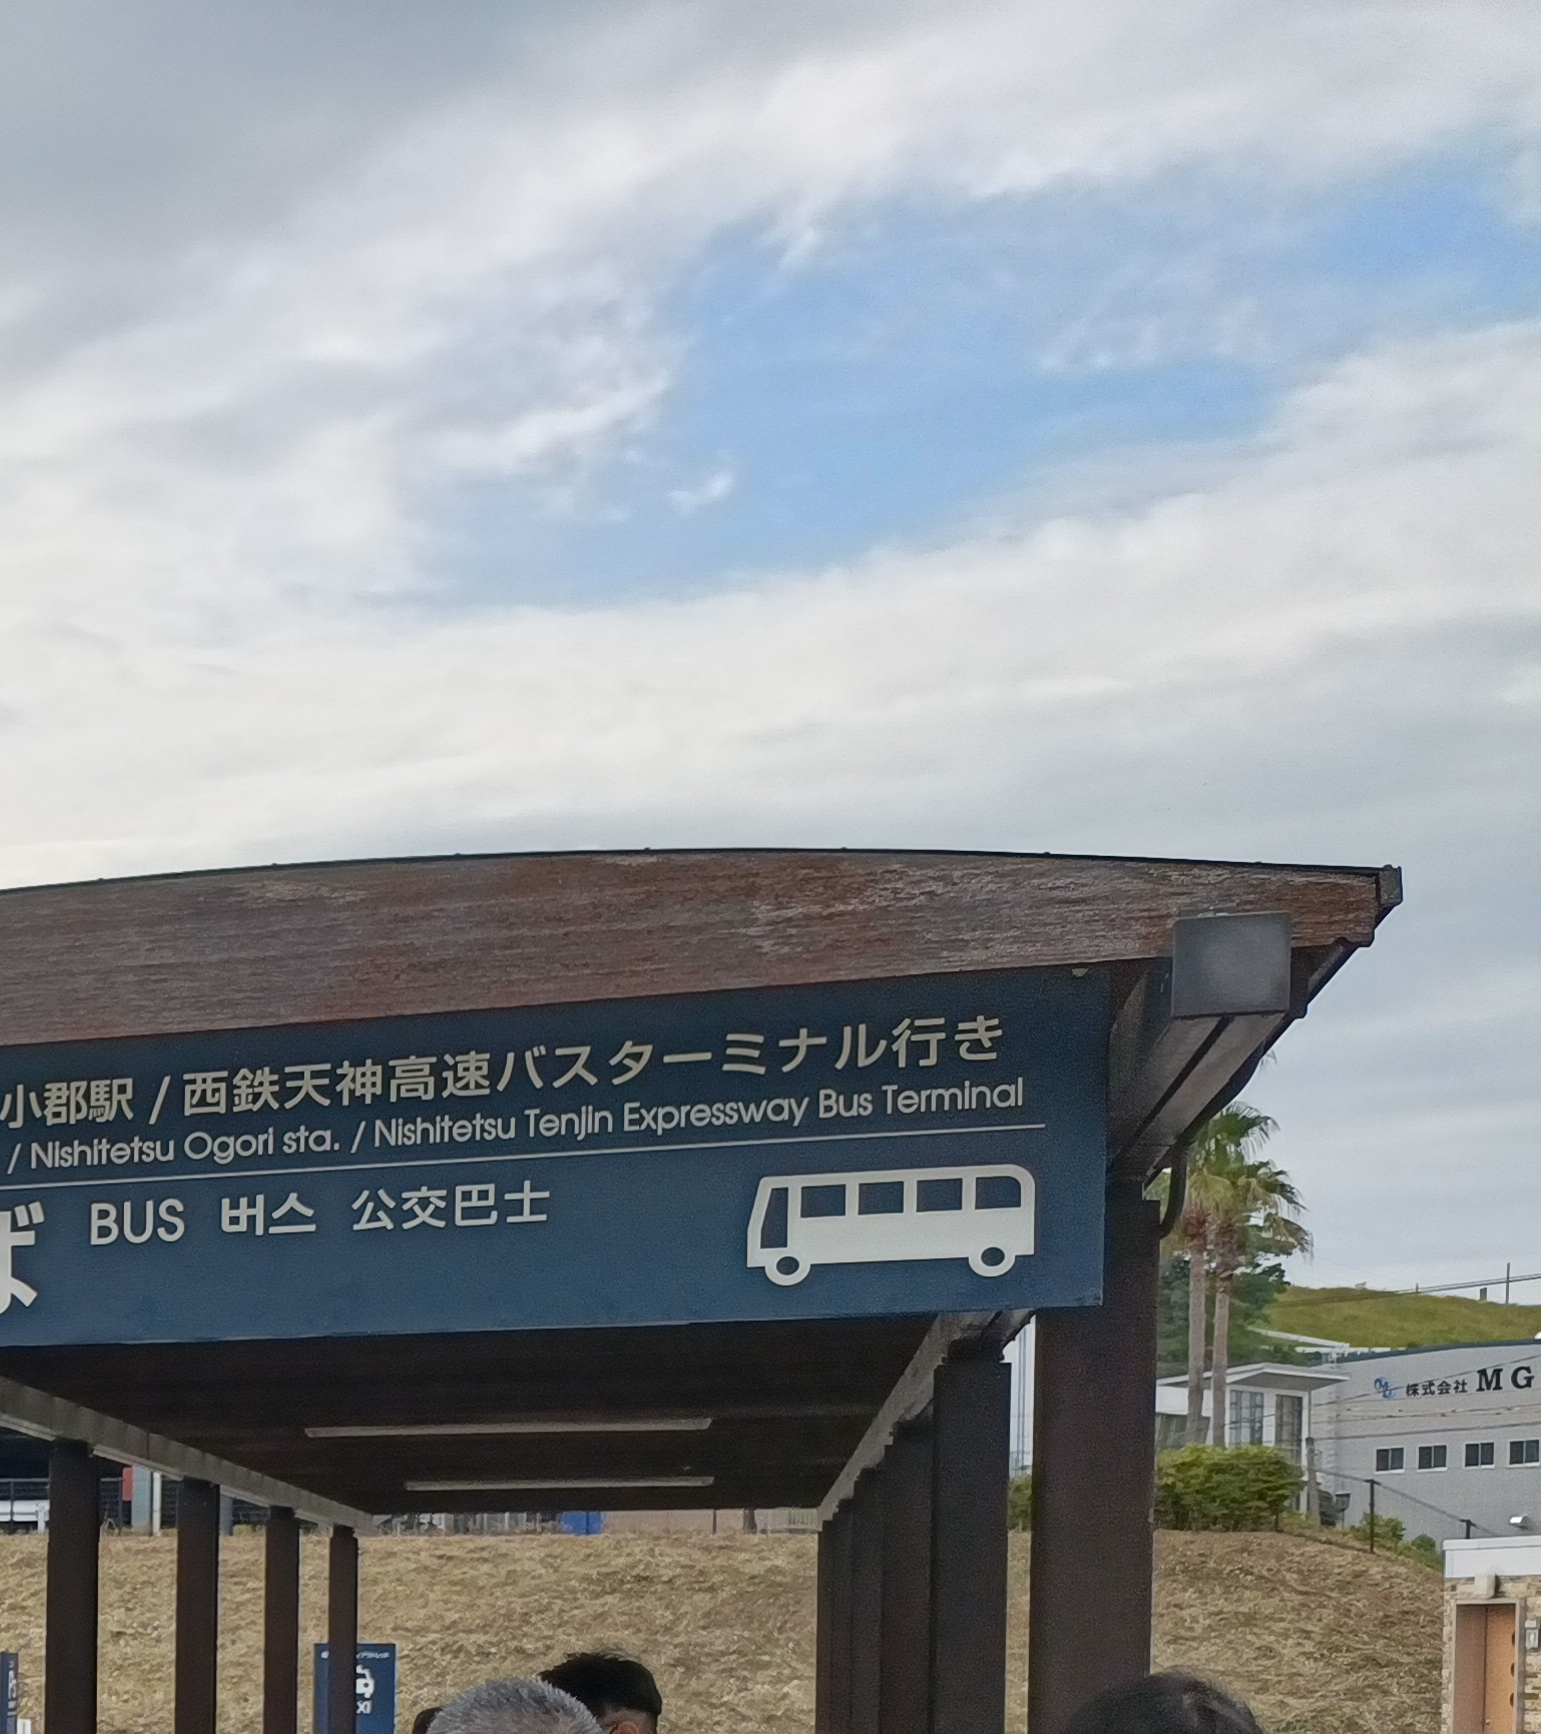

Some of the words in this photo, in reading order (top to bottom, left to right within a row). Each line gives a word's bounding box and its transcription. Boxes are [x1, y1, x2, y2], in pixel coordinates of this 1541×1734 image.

[183, 1014, 1004, 1117] 西鉄天神高速バスターミナル行き
[31, 1134, 175, 1170] Nishitetsu
[184, 1126, 275, 1167] Ogori
[282, 1126, 341, 1156] sta.
[374, 1112, 517, 1148] Nishitetsu
[524, 1104, 614, 1144] Tenjin
[622, 1092, 810, 1137] Expressway
[818, 1087, 873, 1119] Bus
[882, 1077, 1024, 1115] Terminal
[89, 1198, 185, 1247] BUS
[219, 1192, 317, 1238] 버스
[350, 1179, 552, 1234] 公交巴士
[1405, 1379, 1468, 1397] 株式会社
